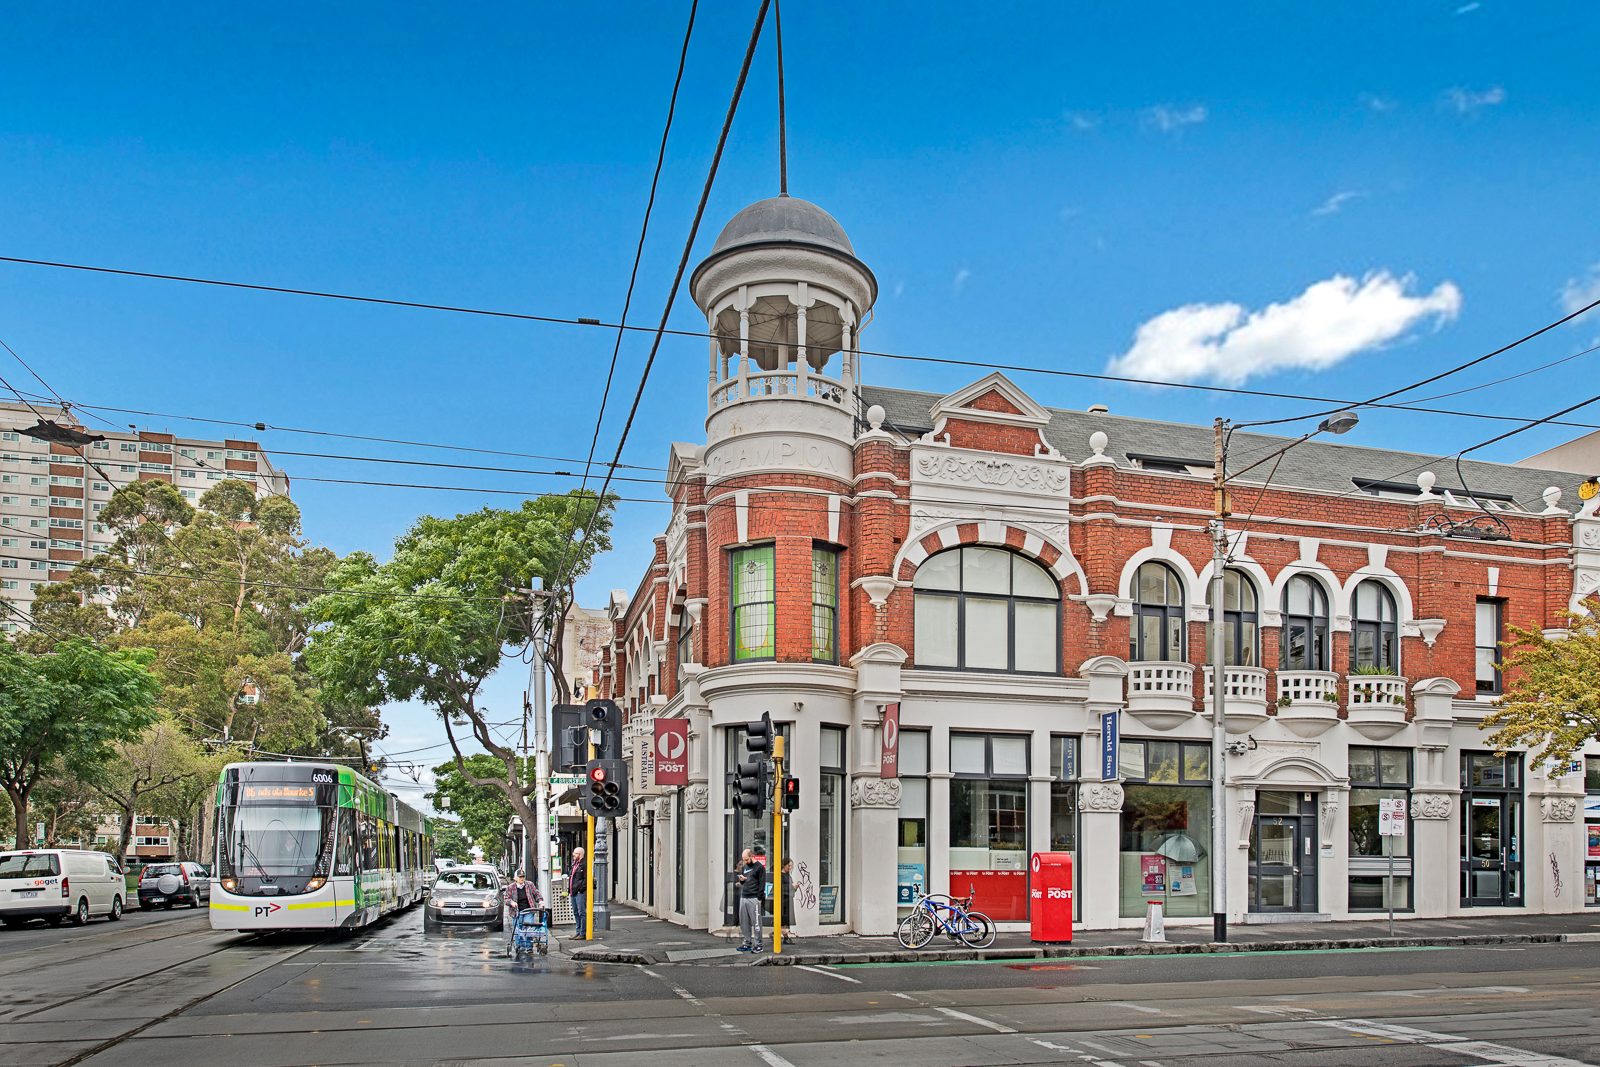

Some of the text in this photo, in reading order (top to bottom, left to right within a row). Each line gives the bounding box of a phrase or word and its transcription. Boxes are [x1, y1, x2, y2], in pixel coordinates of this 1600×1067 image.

[712, 440, 838, 476] CHAMPION
[641, 741, 649, 789] AUSTRALIAN
[882, 755, 896, 765] POST
[658, 764, 684, 773] POST
[313, 773, 333, 783] 6006
[283, 787, 308, 797] Bourke
[1272, 817, 1283, 826] 52
[1481, 859, 1490, 868] 50
[1048, 890, 1073, 899] POST
